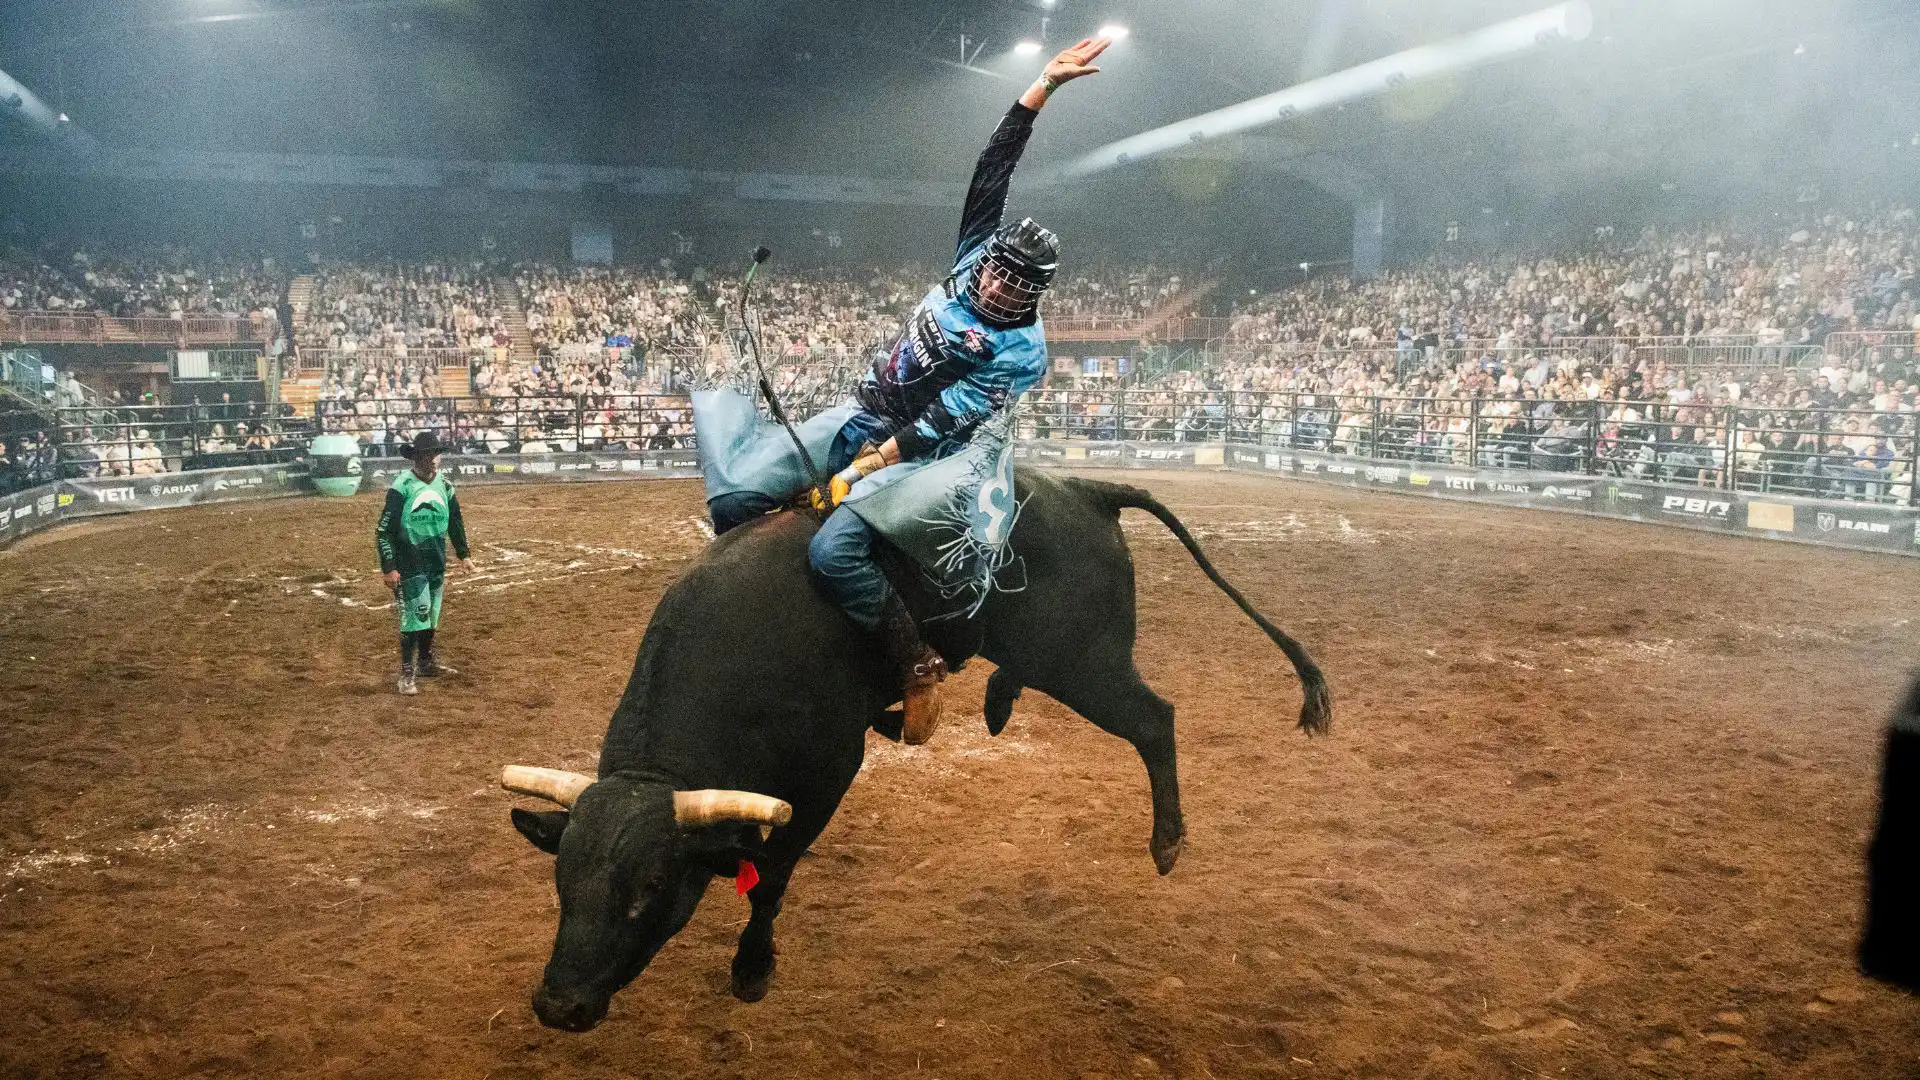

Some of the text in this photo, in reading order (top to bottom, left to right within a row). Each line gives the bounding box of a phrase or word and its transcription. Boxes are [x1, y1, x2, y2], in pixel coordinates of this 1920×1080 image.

[458, 465, 486, 474] YETI
[161, 484, 199, 496] ARIAT
[1444, 475, 1477, 491] YETI
[1497, 484, 1530, 494] ARIAT
[93, 486, 136, 503] YETI
[1662, 495, 1730, 516] PBR
[1838, 520, 1890, 534] RAM
